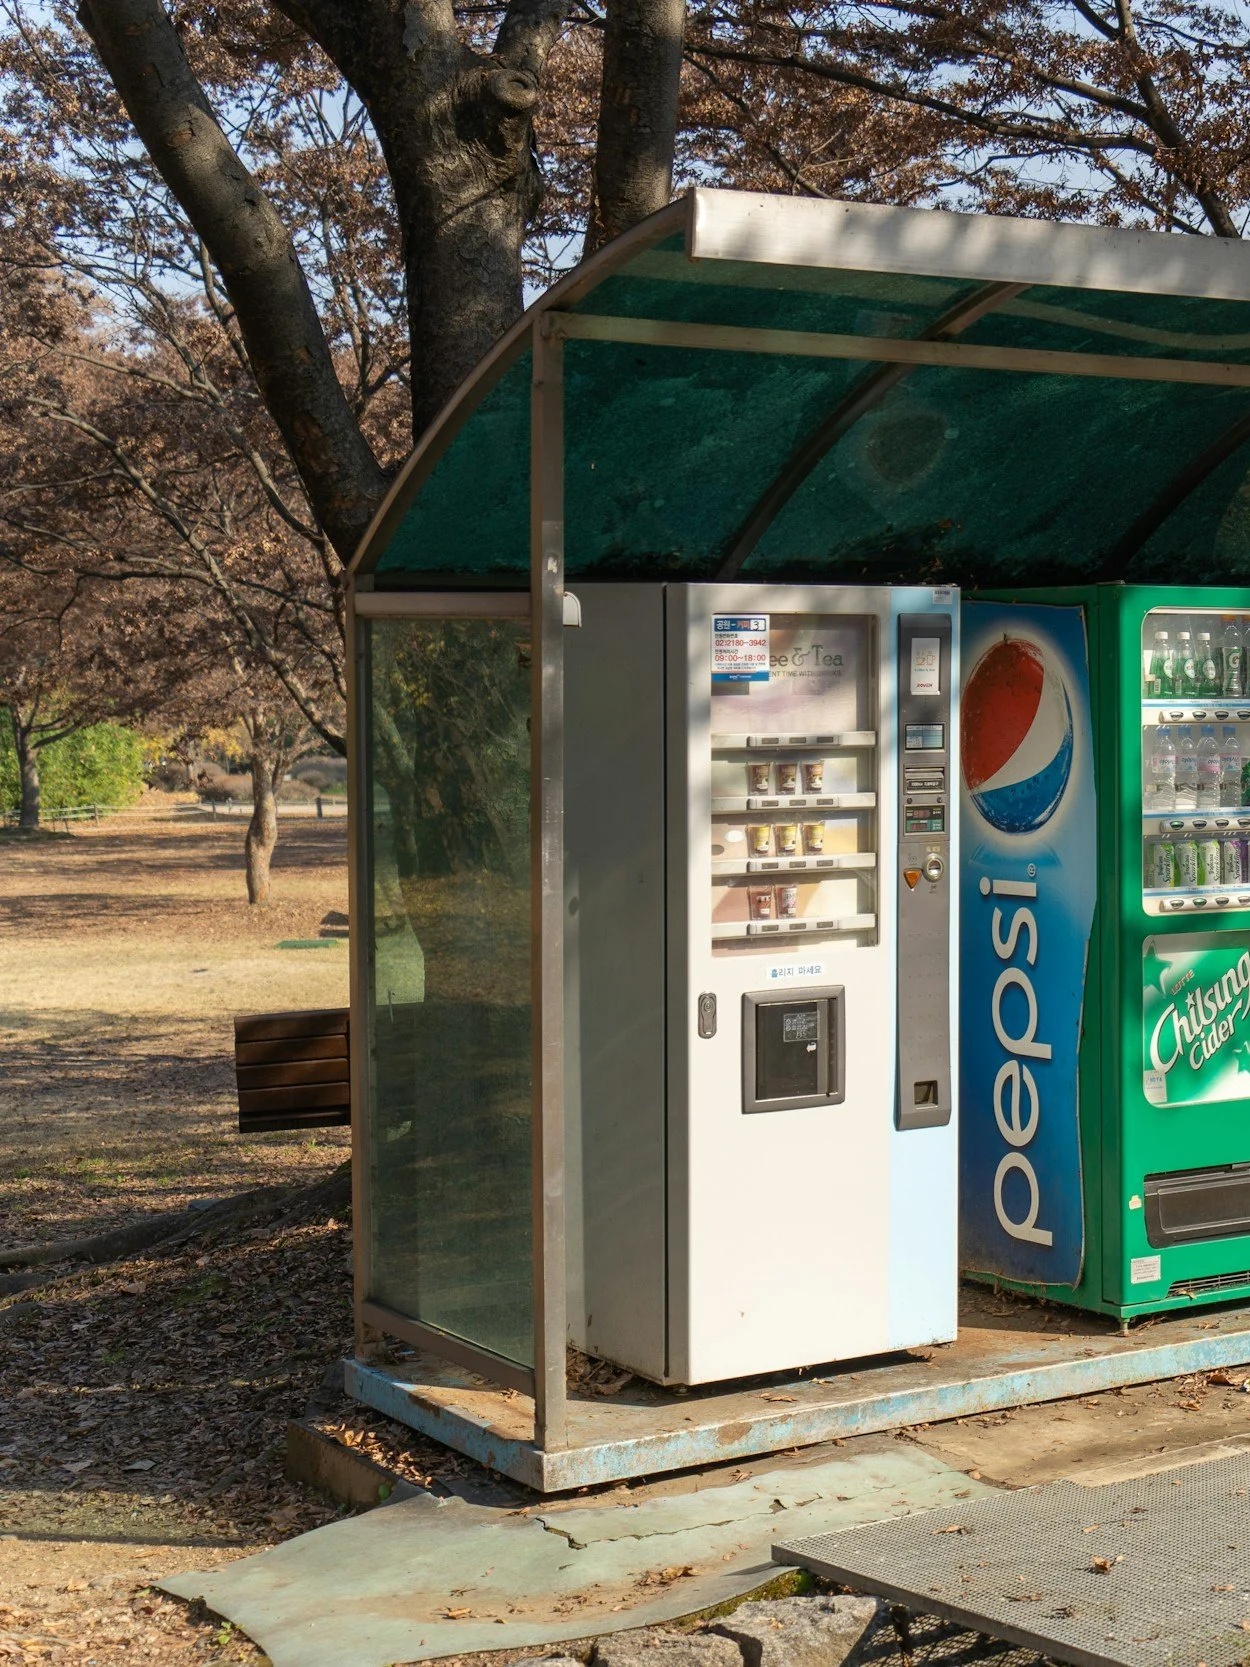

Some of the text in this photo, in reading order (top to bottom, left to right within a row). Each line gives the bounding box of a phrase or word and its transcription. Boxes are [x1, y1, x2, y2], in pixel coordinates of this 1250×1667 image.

[715, 654, 766, 662] 09:00~18:00
[811, 644, 844, 667] Tea
[1163, 850, 1172, 882] Sparkling
[798, 965, 822, 975] 마세요
[1170, 969, 1195, 996] LOTTE
[1190, 998, 1243, 1070] Cider
[980, 876, 1053, 1247] pepsi
